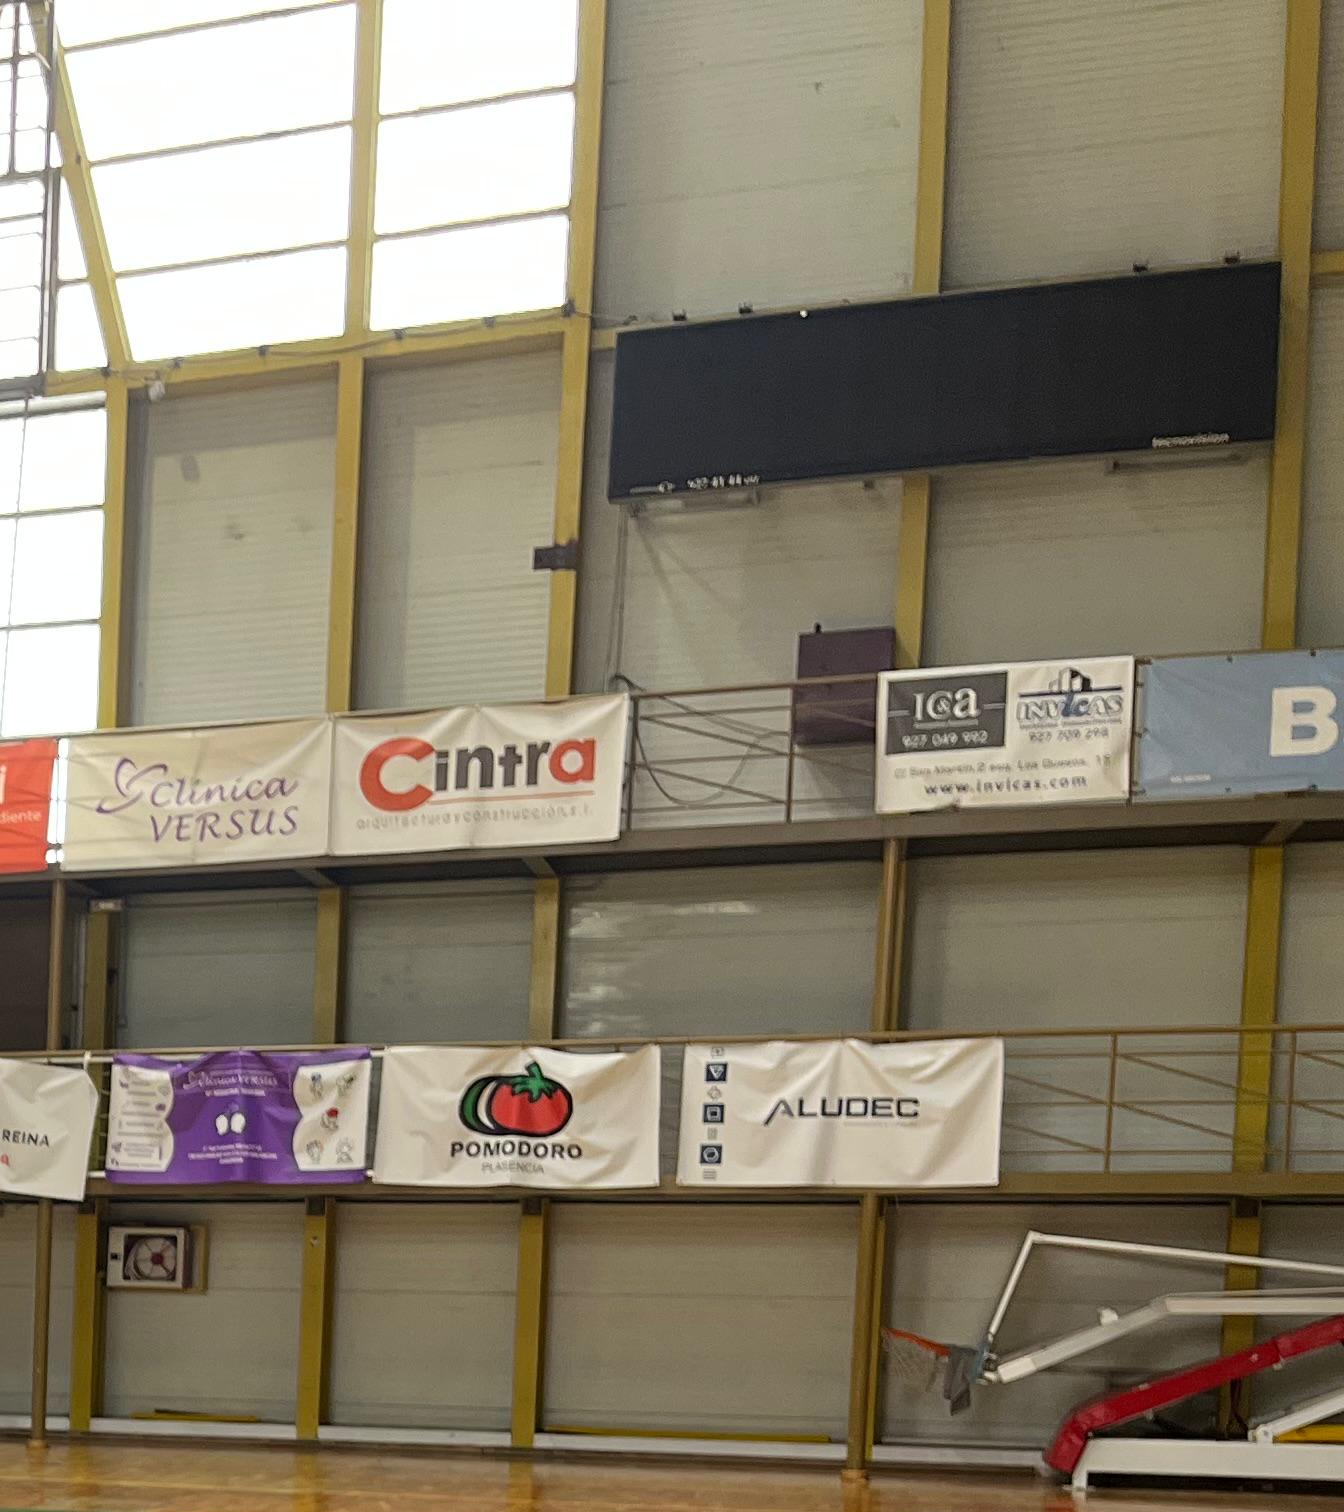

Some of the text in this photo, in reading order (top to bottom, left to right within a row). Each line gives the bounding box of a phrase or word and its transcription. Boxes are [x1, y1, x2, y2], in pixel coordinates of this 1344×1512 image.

[1269, 686, 1338, 758] B
[359, 736, 597, 812] Cintra
[924, 776, 1088, 796] www.invicas.com
[151, 806, 300, 843] VERSUS
[763, 1097, 921, 1127] ALUDEC
[1, 1128, 51, 1148] REINA
[450, 1140, 583, 1159] POMODORO
